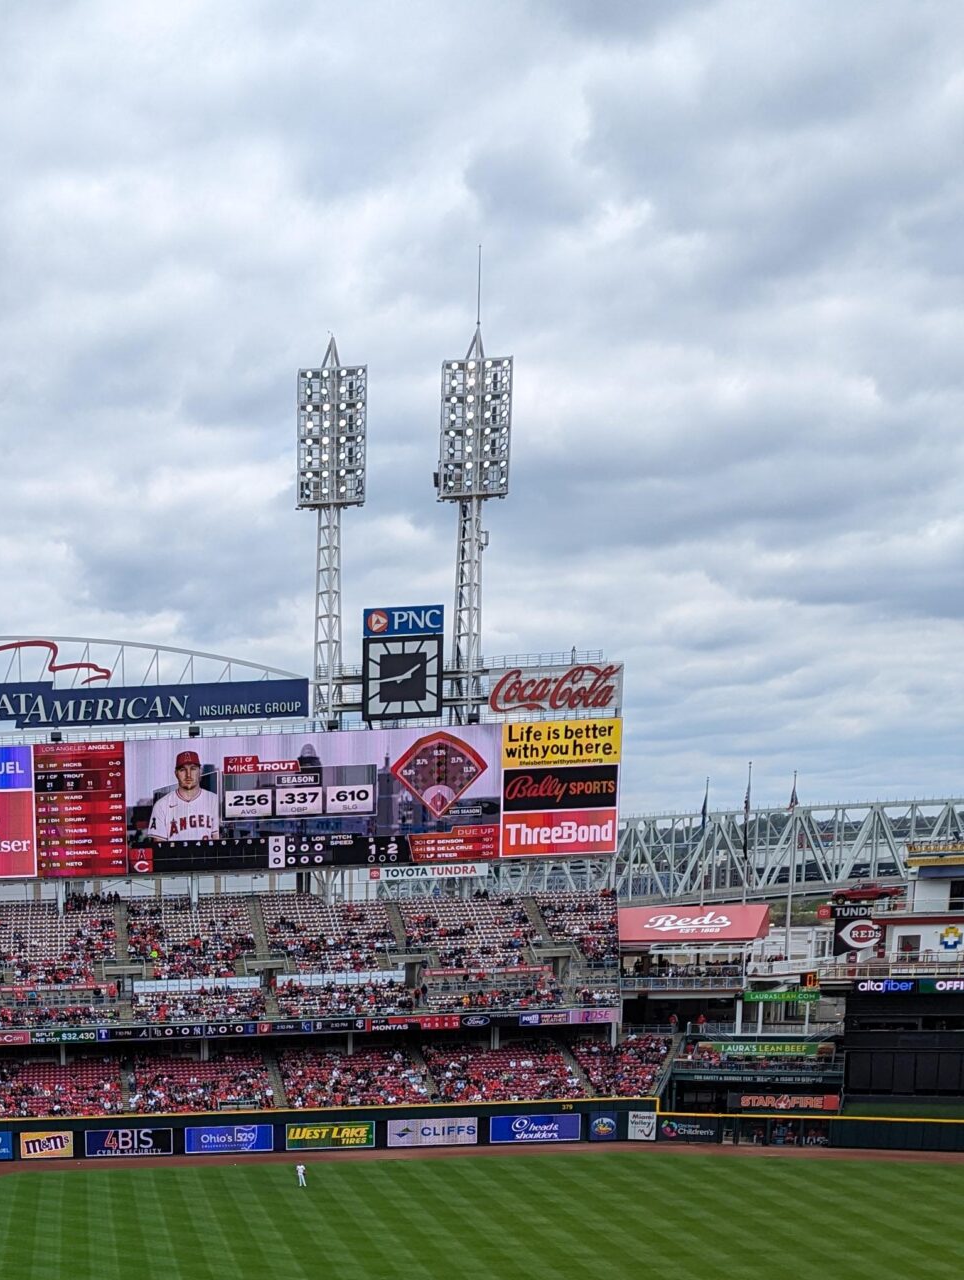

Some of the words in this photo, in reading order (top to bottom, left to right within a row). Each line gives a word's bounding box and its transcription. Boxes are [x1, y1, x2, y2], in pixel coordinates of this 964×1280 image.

[393, 610, 442, 630] PNC
[489, 664, 621, 712] Coca-Cola
[23, 694, 187, 724] AMERICAN
[198, 702, 262, 717] INSURANCE
[264, 701, 301, 714] GROUP
[508, 725, 542, 742] Life
[547, 726, 560, 740] is
[564, 724, 614, 739] better
[56, 744, 87, 752] ANGELES
[505, 743, 539, 759] with
[541, 743, 569, 762] you
[572, 740, 618, 756] here.
[227, 764, 254, 772] MIKE
[256, 762, 296, 771] TROUT
[282, 776, 315, 784] SEASON
[505, 775, 567, 802] Bally
[568, 780, 615, 794] SPORTS
[228, 794, 269, 807] .256
[280, 792, 319, 804] .337
[331, 790, 369, 802] .610
[506, 820, 612, 846] ThreeBond
[385, 868, 427, 877] TOYOTA
[430, 866, 477, 875] TUNDRA
[836, 906, 874, 917] TUNDR
[644, 912, 732, 932] Reds
[851, 930, 882, 938] REDS
[858, 979, 914, 992] altafiber
[61, 1032, 95, 1040] $32,430
[785, 1044, 807, 1052] BEEF
[740, 1095, 777, 1107] STAR
[790, 1096, 823, 1108] FIRE
[630, 1120, 652, 1128] Valley
[288, 1127, 329, 1140] WEST
[332, 1125, 370, 1138] LAKE
[420, 1125, 476, 1137] CLIFFS
[515, 1131, 558, 1140] shoulders
[678, 1128, 715, 1136] Children's
[104, 1129, 153, 1150] 4BIS
[201, 1134, 233, 1143] Ohio's
[237, 1133, 255, 1142] 529
